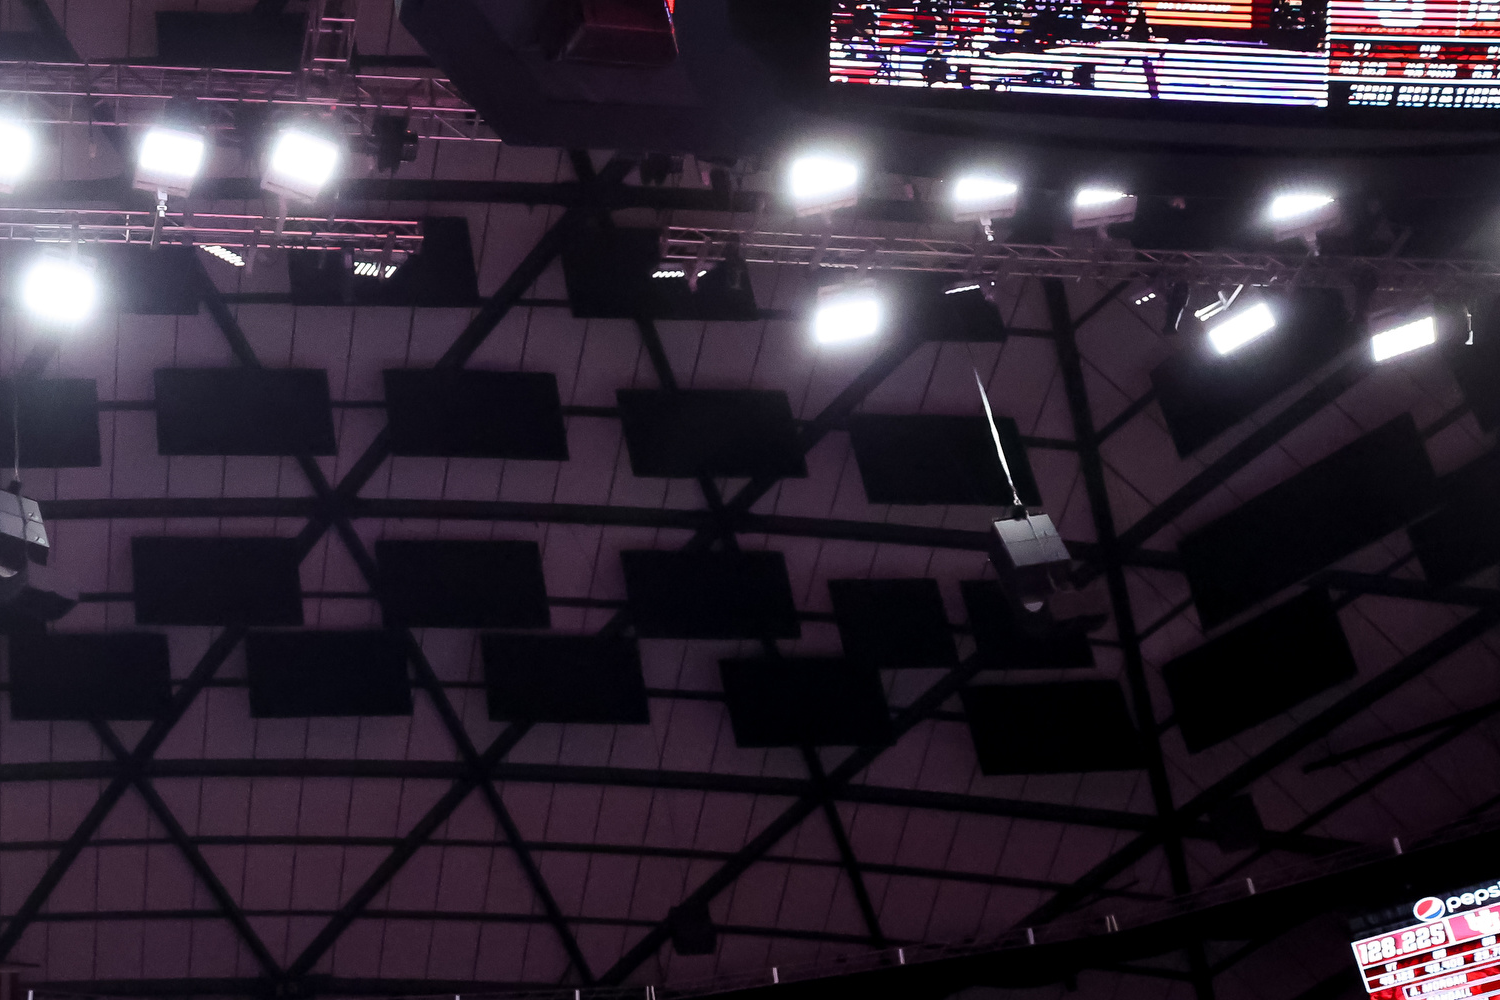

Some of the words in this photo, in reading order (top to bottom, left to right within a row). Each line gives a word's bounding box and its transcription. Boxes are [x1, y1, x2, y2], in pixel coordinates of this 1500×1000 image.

[1445, 880, 1500, 914] peps
[1357, 921, 1446, 966] 128.225
[1421, 974, 1467, 994] MORGAN
